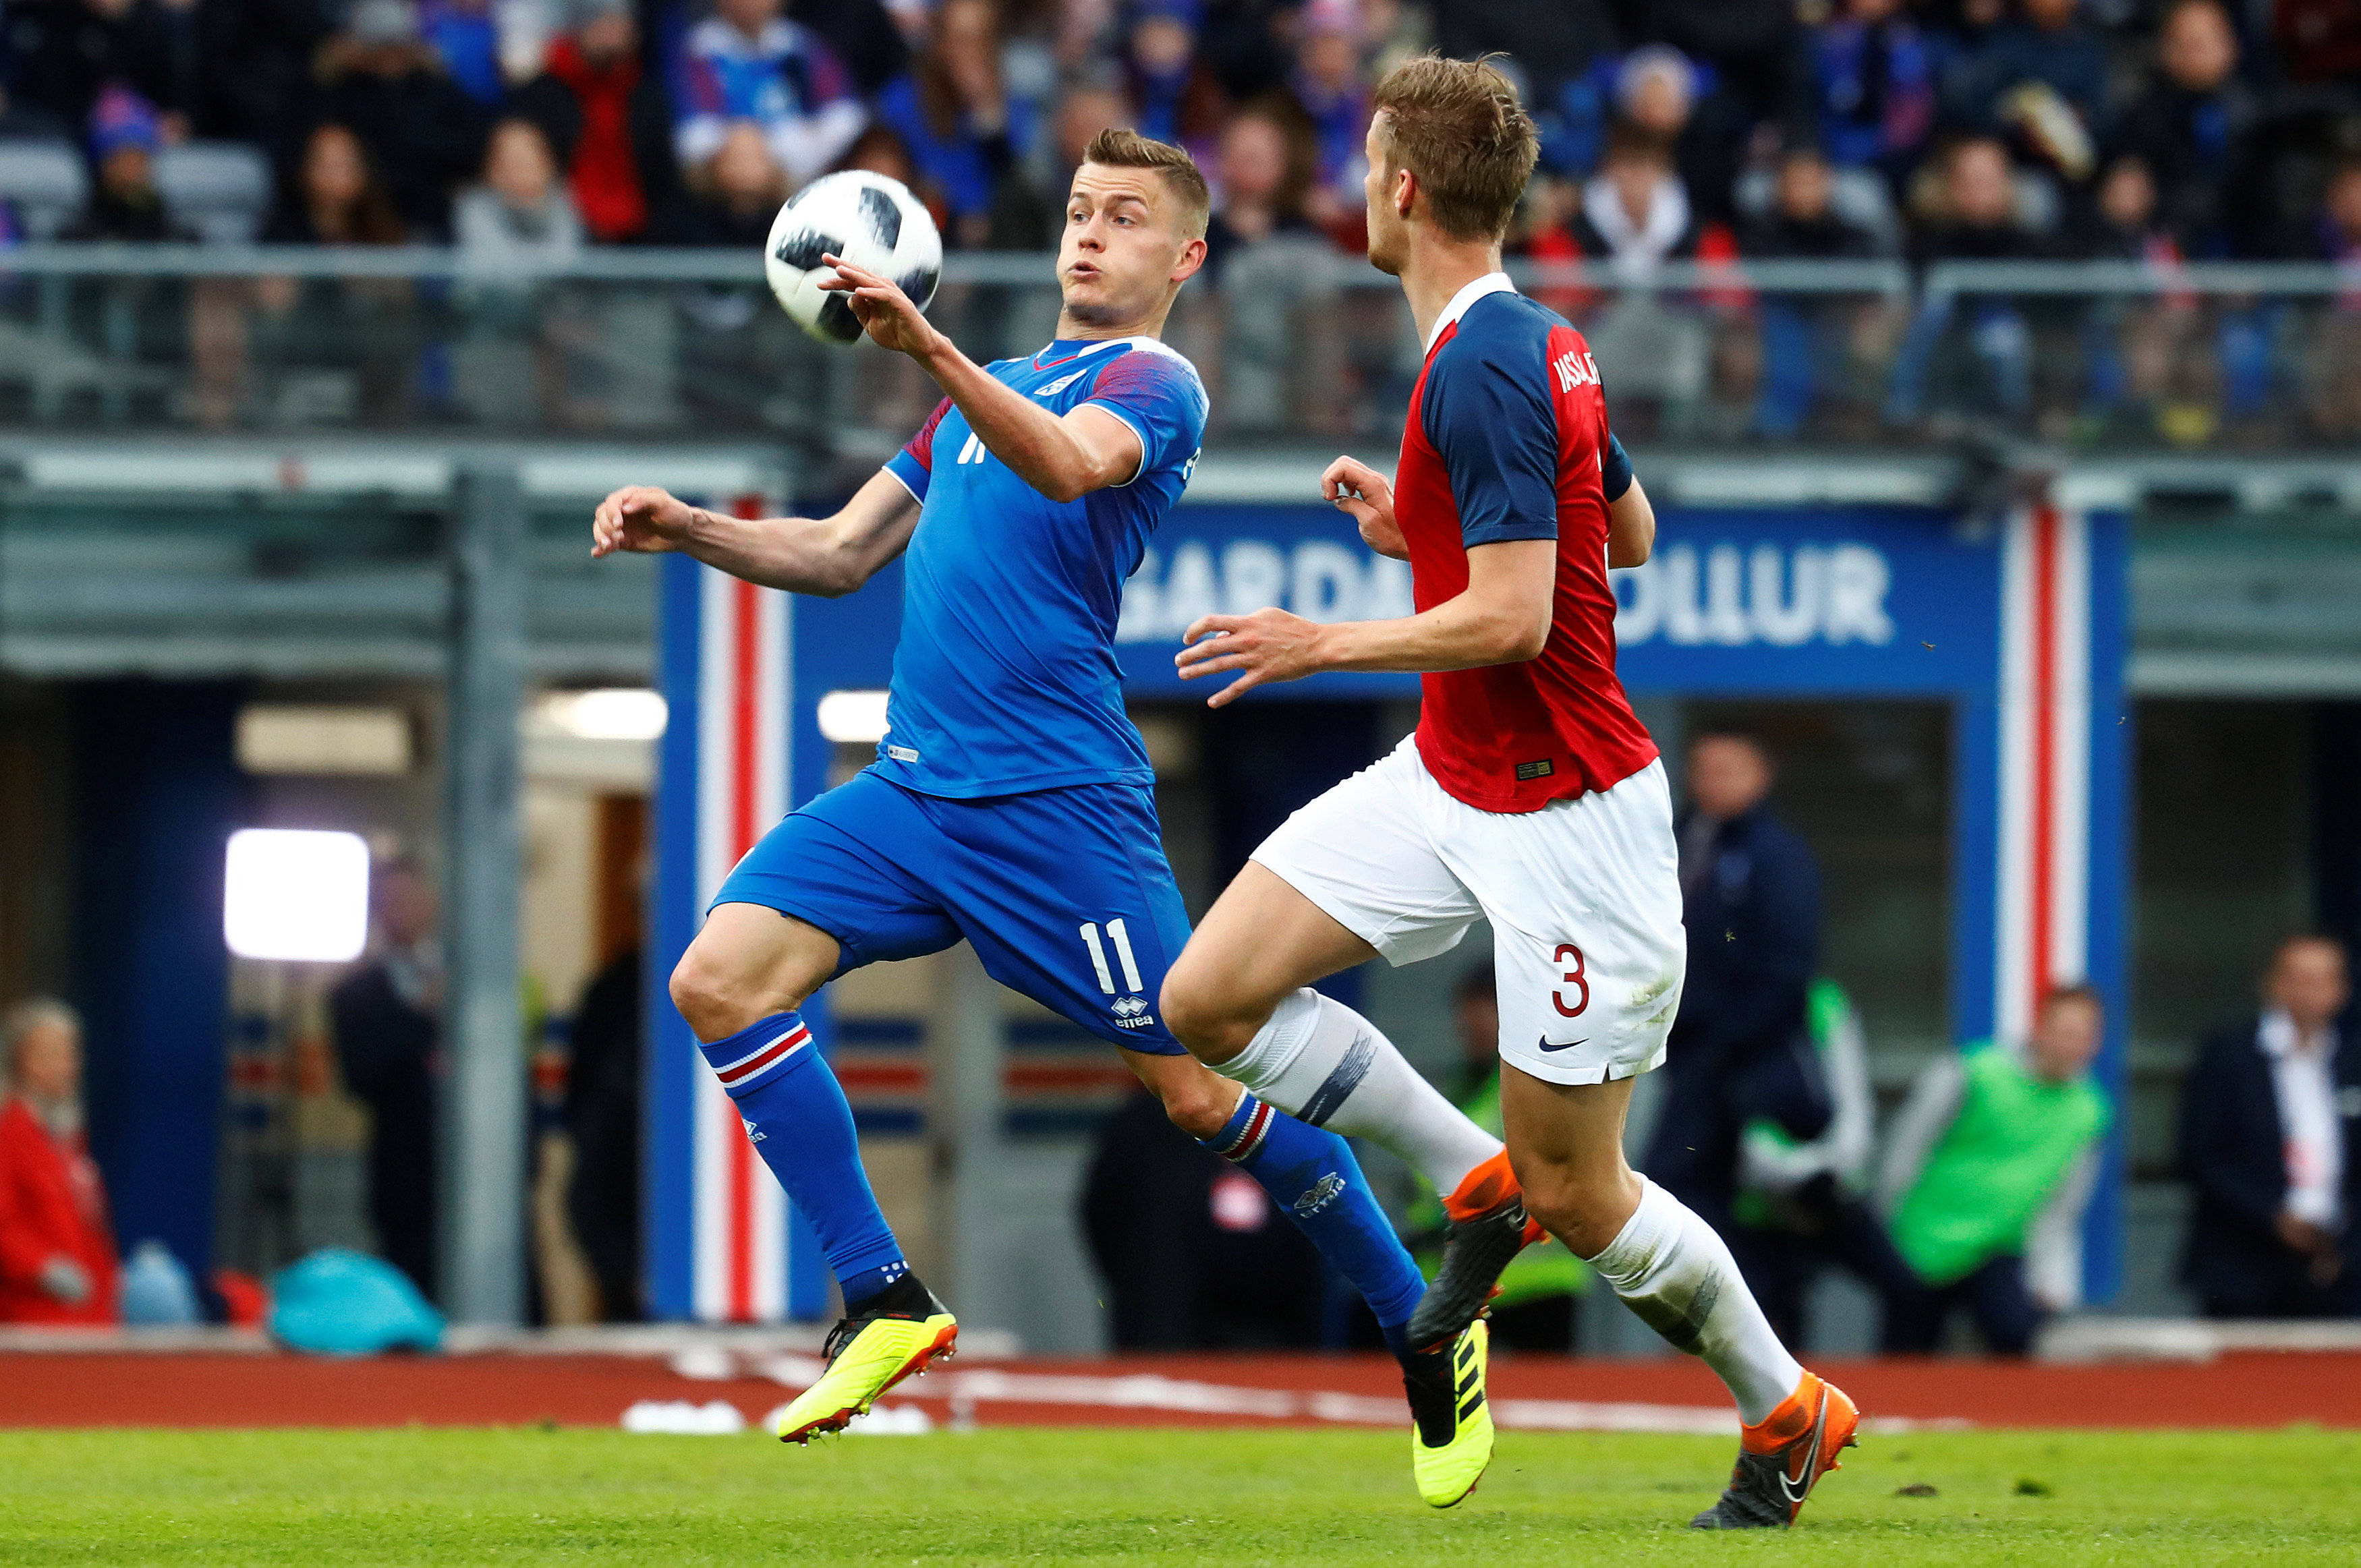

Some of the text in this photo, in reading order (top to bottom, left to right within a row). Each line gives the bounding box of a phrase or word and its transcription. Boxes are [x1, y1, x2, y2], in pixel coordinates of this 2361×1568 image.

[1079, 918, 1143, 994] 11
[1552, 943, 1589, 1018] 3
[1115, 1015, 1154, 1028] errea
